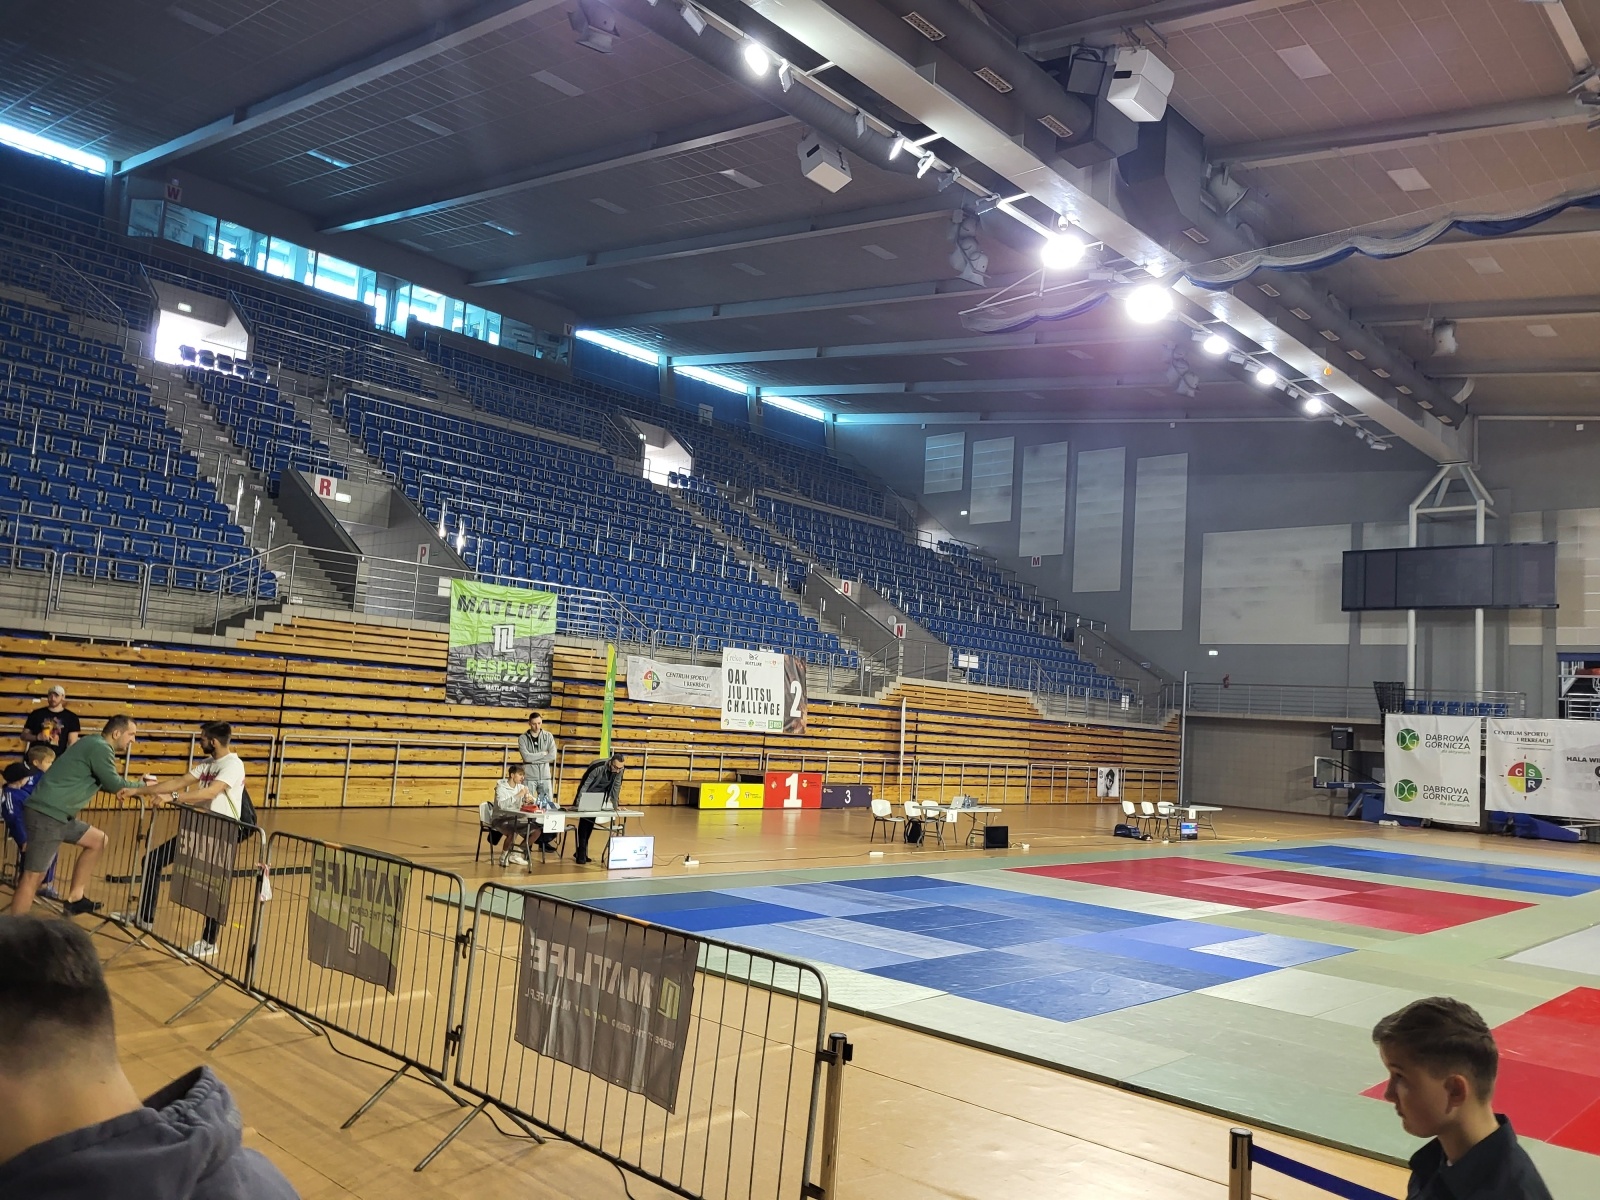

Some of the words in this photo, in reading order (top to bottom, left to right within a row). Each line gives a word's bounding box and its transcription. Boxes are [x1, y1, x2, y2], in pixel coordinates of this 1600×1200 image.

[167, 185, 181, 200] W
[319, 477, 331, 497] R
[420, 546, 427, 563] P
[1032, 556, 1040, 566] M
[456, 594, 552, 621] MATLIFE
[896, 624, 903, 638] N
[466, 657, 538, 677] RESPECT
[665, 671, 690, 680] CENTRUM
[690, 674, 709, 682] SPORTU
[727, 668, 747, 686] OAK
[727, 685, 742, 700] JIU
[746, 686, 772, 703] JITSU
[790, 680, 802, 718] 2
[727, 699, 780, 716] CHALLENGE
[1425, 733, 1470, 743] DĄBROWA
[1520, 737, 1552, 745] REKREACJI
[1566, 756, 1588, 764] HALA
[725, 782, 741, 808] 2
[783, 773, 803, 808] 1
[845, 789, 853, 805] 3
[1423, 784, 1469, 795] DĄBROWA
[551, 820, 558, 831] 2
